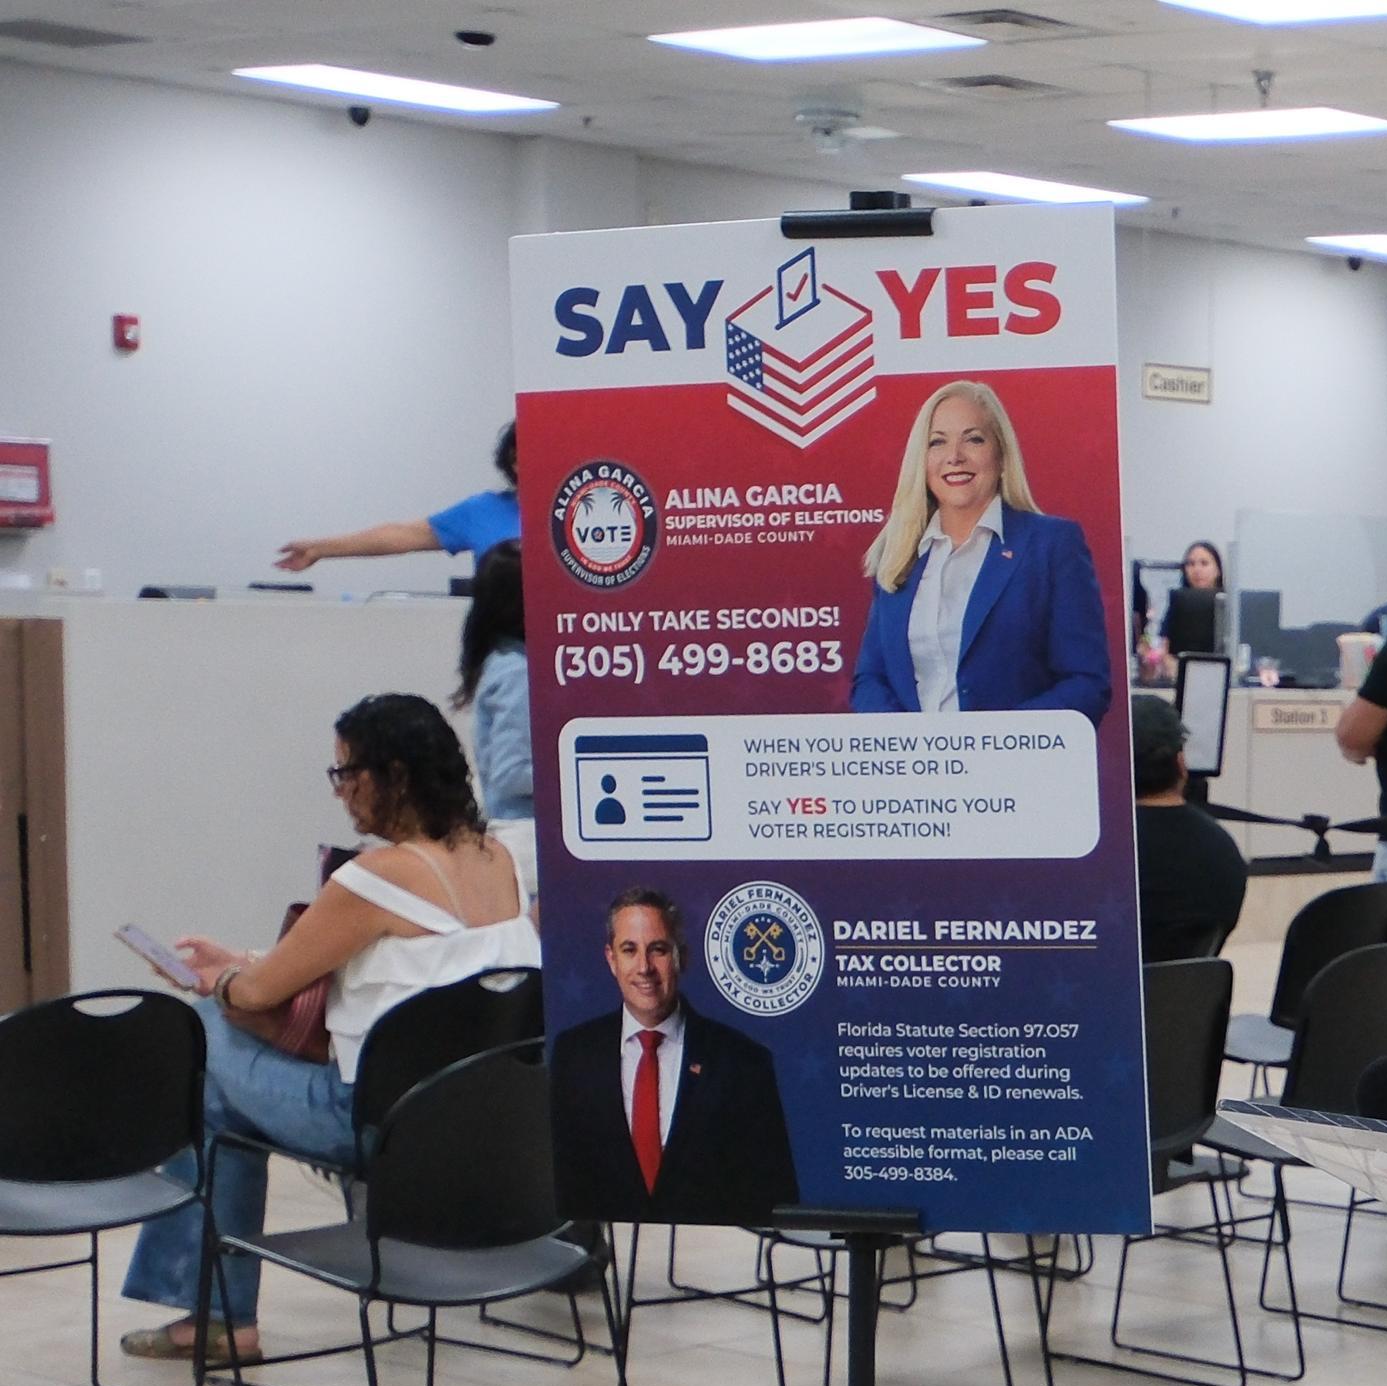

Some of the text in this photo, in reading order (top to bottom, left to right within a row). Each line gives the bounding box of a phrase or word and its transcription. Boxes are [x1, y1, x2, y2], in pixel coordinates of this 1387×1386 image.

[554, 262, 1062, 357] SAY YES
[555, 465, 654, 520] ALINA GARCIA
[665, 483, 843, 509] ALINA GARCIA
[665, 509, 884, 530] SUPERVISOR OF ELECTIONS
[576, 526, 631, 543] VOTE
[666, 531, 815, 546] MIAMI-DADE COUNTY
[561, 545, 651, 586] SUPERVISOR OF ELECTIONS
[557, 606, 840, 633] IT ONLY TAKE SECONDS!
[555, 640, 843, 686] (305) 499-8683
[744, 735, 1065, 753] WHEN YOU RENEW YOUR FLORIDA
[745, 760, 968, 777] DRIVER'S LICENSE OR ID.
[748, 798, 1016, 815] SAY YES TO UPDATING YOUR
[749, 822, 951, 838] VOTER REGISTRATION!
[711, 888, 816, 942] DARIEL FERNANDEZ
[833, 920, 1097, 940] DARIEL FERNANDEZ
[835, 955, 1001, 972] TAX COLLECTOR
[719, 972, 813, 1009] TAX COLLECTOR
[837, 976, 1000, 988] MIAMI-DADE COUNTY
[838, 1022, 891, 1037] Florida
[896, 1023, 954, 1037] Statute
[959, 1023, 1019, 1038] Section
[839, 1044, 1046, 1061] requires voter registration
[840, 1063, 1070, 1082] updates to be offered during
[841, 1083, 1083, 1100] Driver's License & ID renewals.
[842, 1124, 1093, 1141] To request materials in an ADA
[843, 1144, 1076, 1162] accessible format, please call
[844, 1166, 958, 1181] 305-499-8384.
